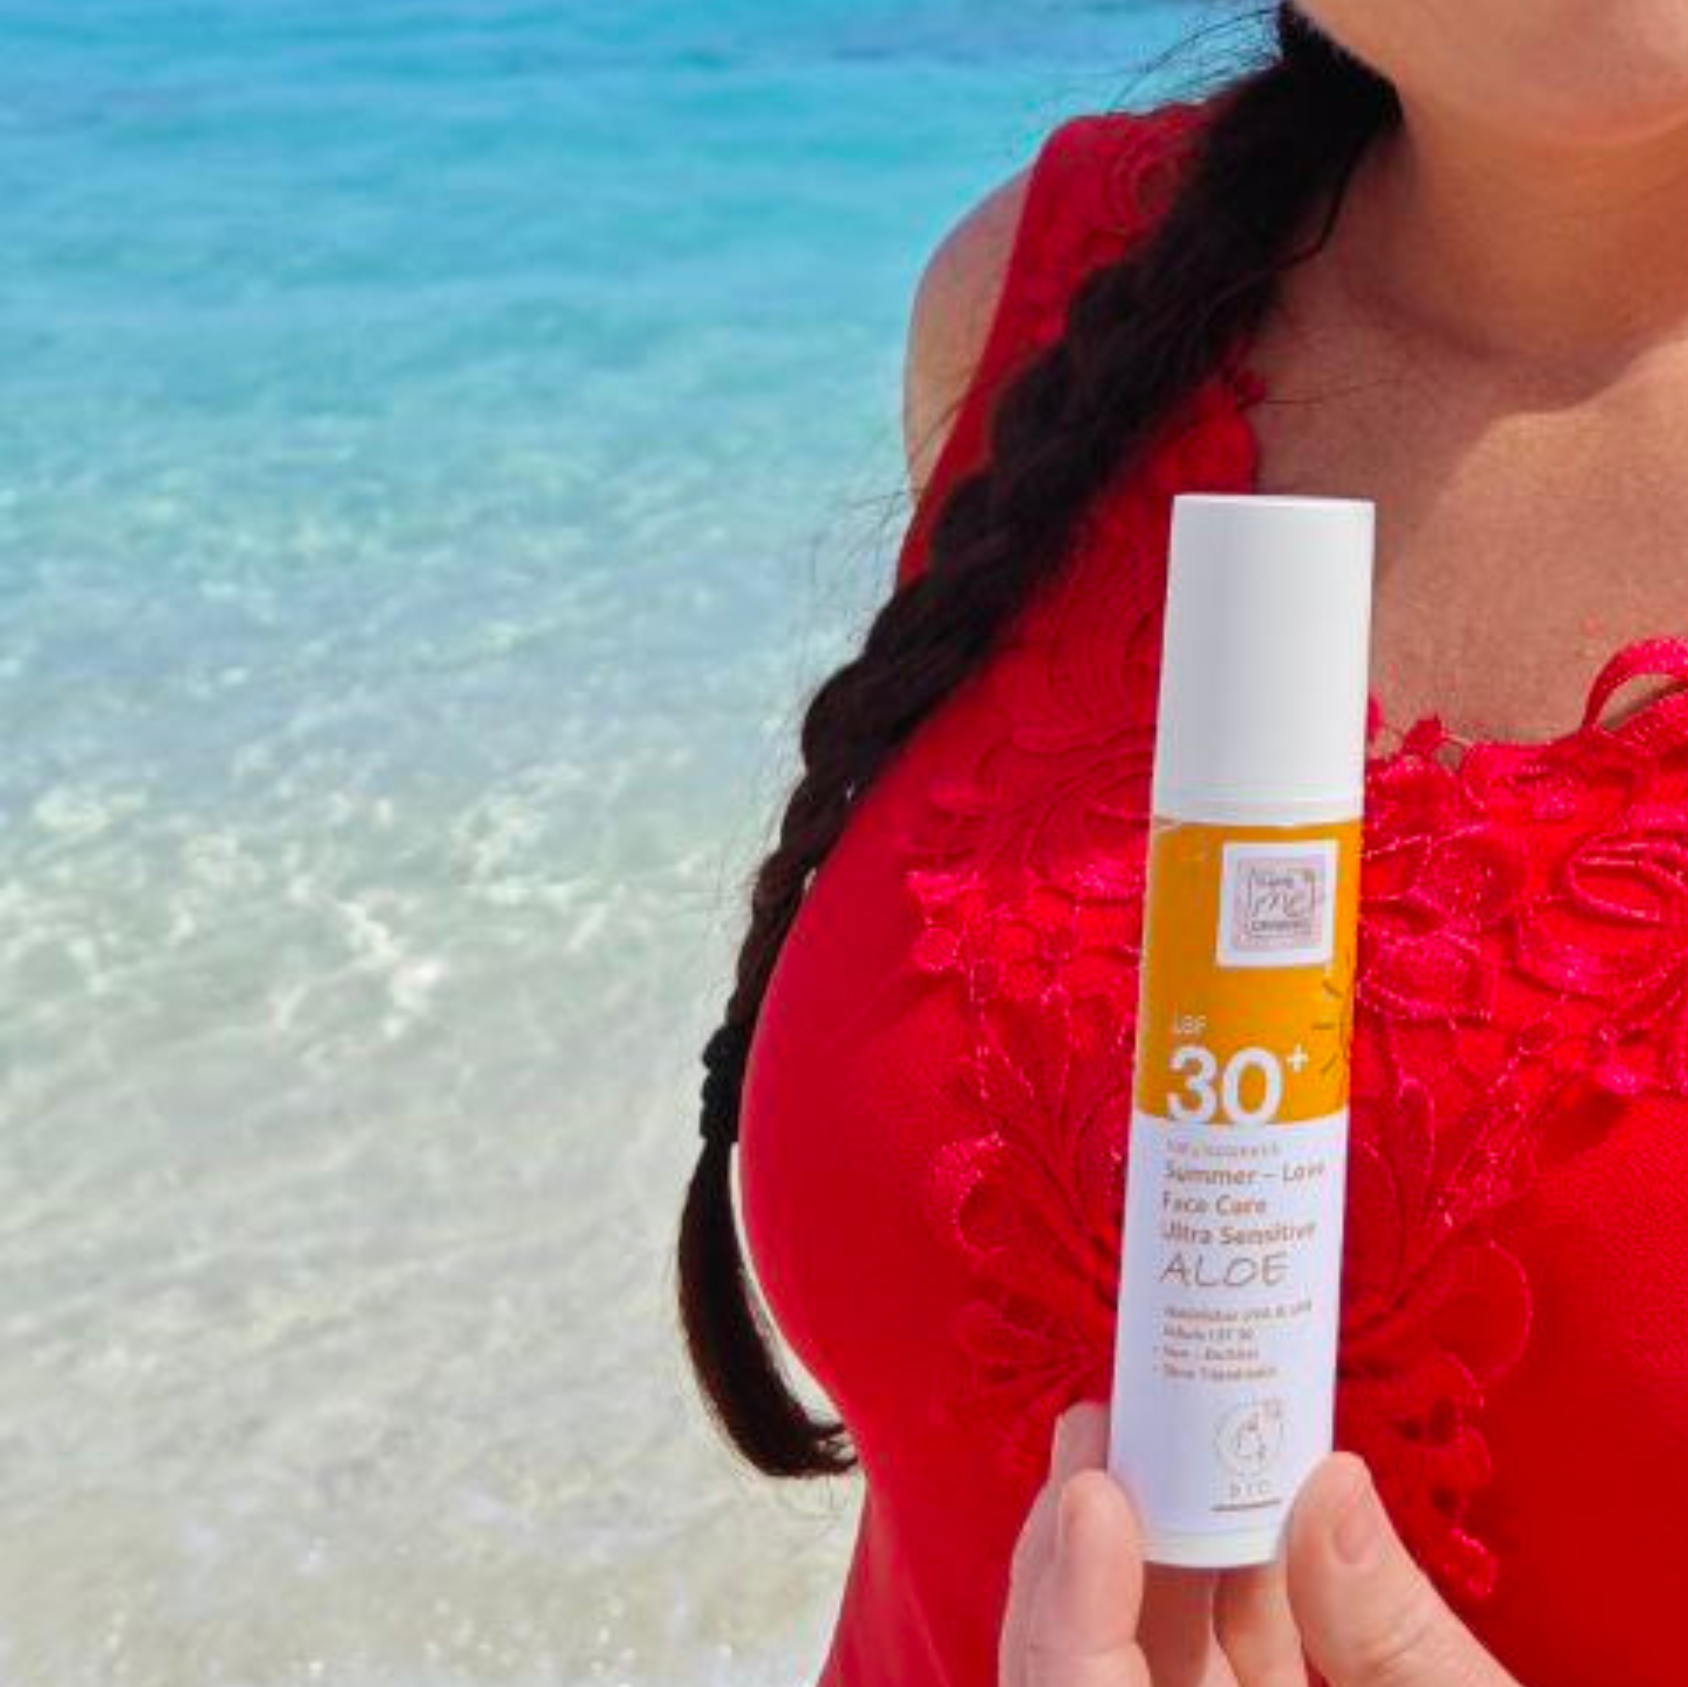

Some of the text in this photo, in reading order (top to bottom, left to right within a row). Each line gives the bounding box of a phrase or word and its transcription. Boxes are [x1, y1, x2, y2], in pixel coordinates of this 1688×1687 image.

[1162, 1160, 1258, 1186] Summer
[1162, 1191, 1267, 1216] Face Care
[1162, 1221, 1317, 1246] Ultra Sensitive
[1160, 1250, 1291, 1288] ALOE
